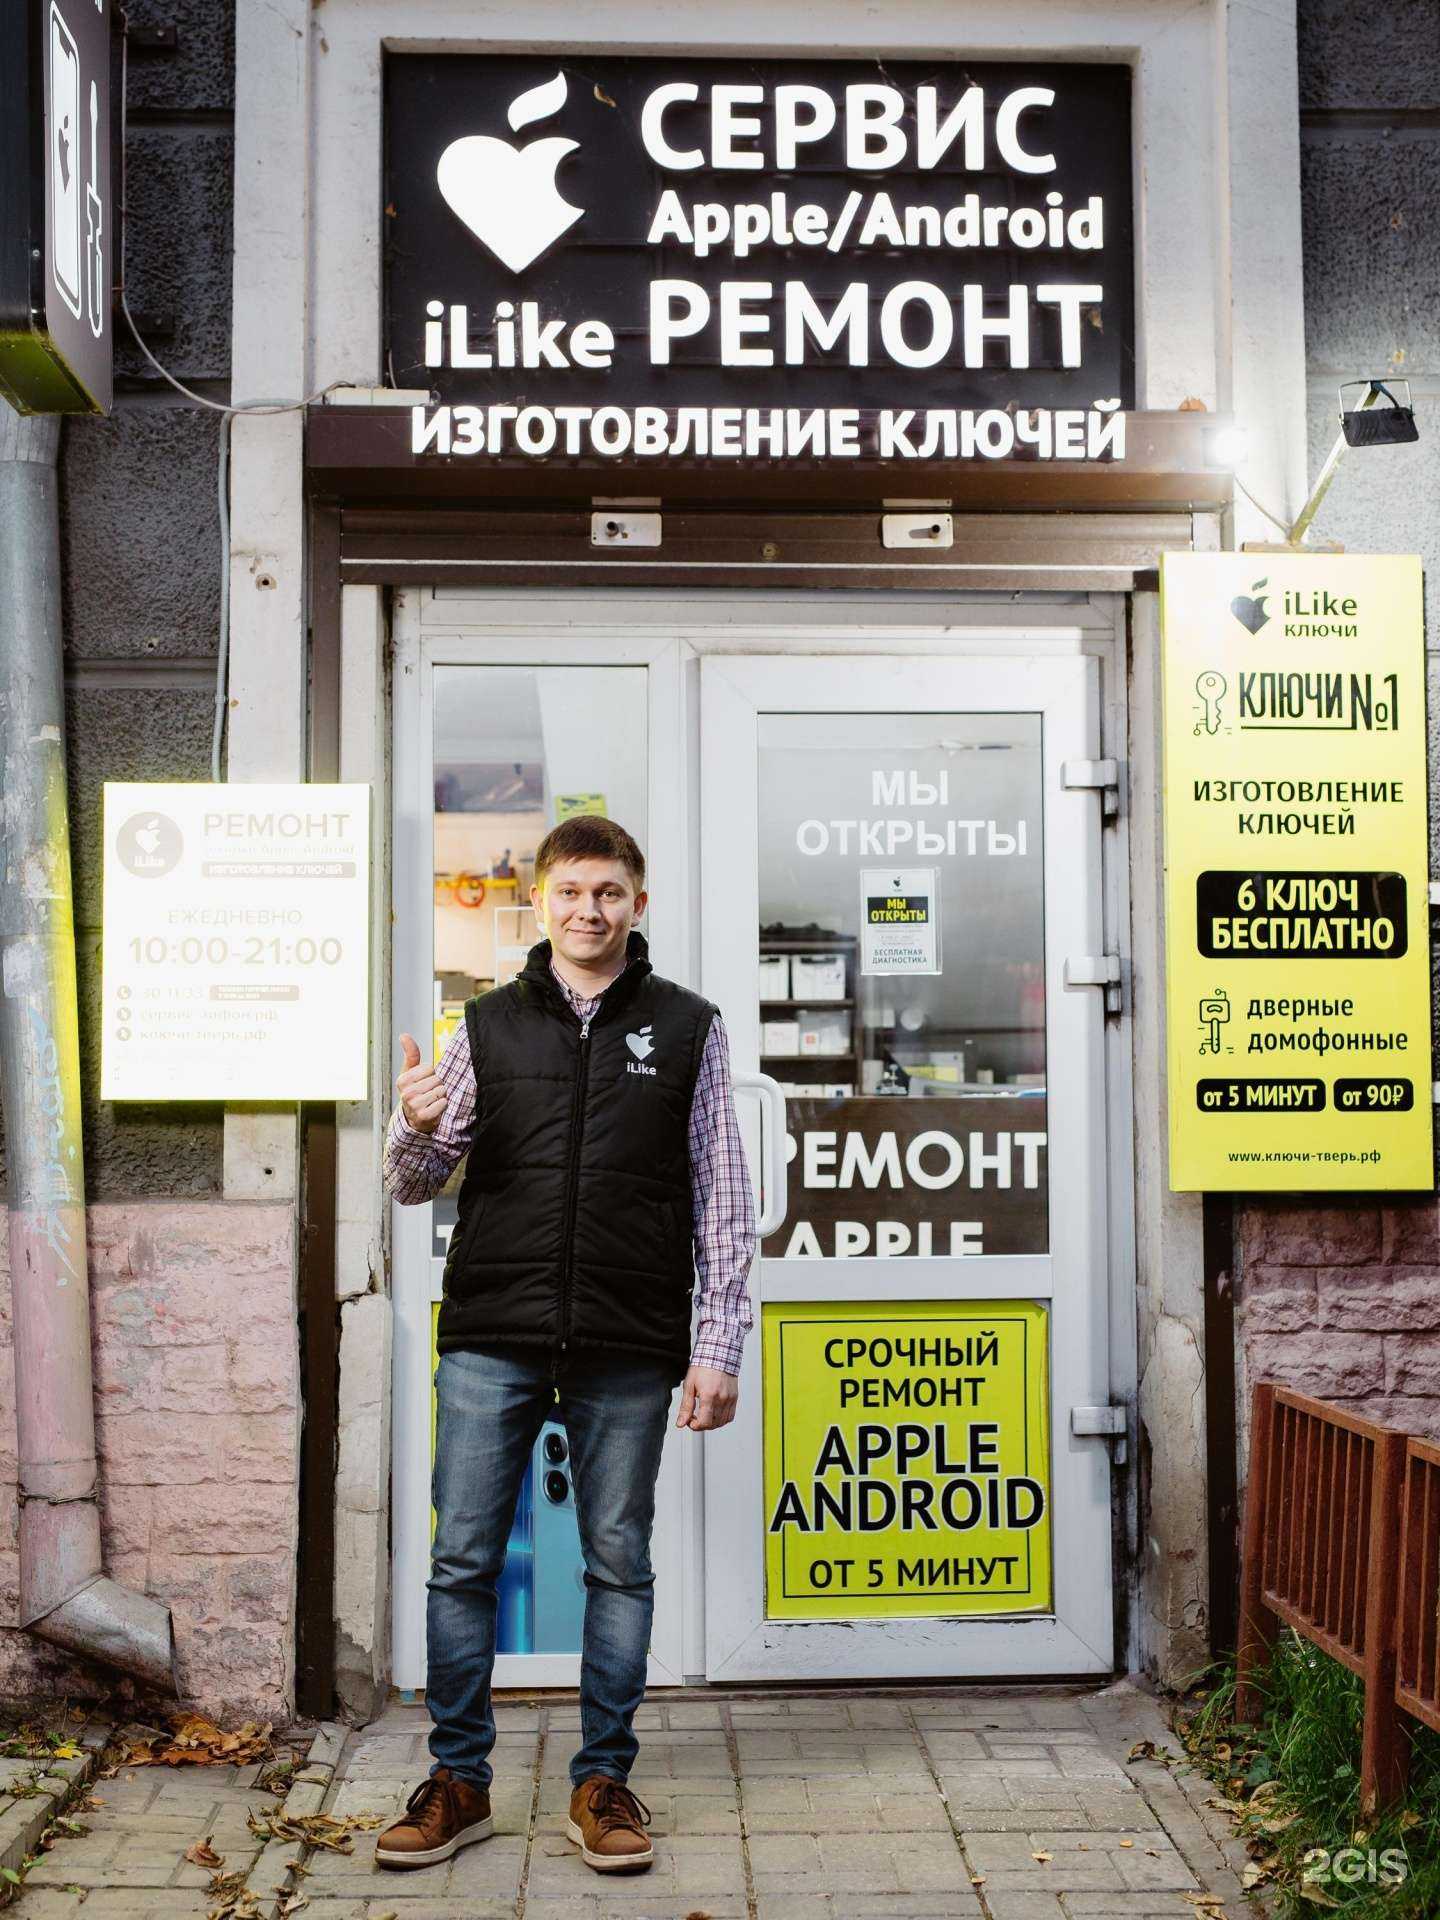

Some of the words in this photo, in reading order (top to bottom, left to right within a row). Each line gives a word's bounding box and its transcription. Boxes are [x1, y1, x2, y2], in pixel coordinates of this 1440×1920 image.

[641, 82, 1058, 174] СЕРВИС
[646, 190, 1104, 257] Apple/Android
[424, 300, 615, 369] iLike
[649, 279, 1104, 370] РЕМОНТ
[410, 405, 861, 457] ИЗГОТОВЛЕНИЕ
[879, 397, 1127, 460] КЛЮЧЕЙ
[1284, 590, 1358, 616] iLike
[1239, 672, 1343, 718] КЛЮЧИ
[872, 770, 948, 805] МЫ
[1193, 780, 1404, 803] ИЗГОТОВЛЕНИЕ
[203, 813, 350, 837] РЕМОНТ
[796, 819, 1027, 856] ОТКРЫТЫ
[1238, 809, 1355, 835] КЛЮЧЕЙ
[886, 898, 906, 910] МЫ
[1237, 879, 1256, 911] 6
[1266, 880, 1358, 911] КЛЮЧ
[167, 910, 303, 926] ЕЖЕДНЕВНО
[871, 909, 926, 922] ОТКРЫТЫ
[1212, 917, 1394, 949] БЕСПЛАТНО
[128, 937, 343, 966] 10:00-21:00
[1247, 998, 1354, 1022] дверные
[1247, 1027, 1408, 1056] домофонные
[626, 1061, 657, 1075] iLike
[1203, 1090, 1223, 1106] от
[1228, 1085, 1239, 1106] 5
[1246, 1085, 1317, 1106] МИНУТ
[1342, 1089, 1362, 1106] от
[1227, 1150, 1381, 1164] www.ключи-тверь.рф
[824, 1330, 999, 1368] СРОЧНЫЙ
[840, 1377, 985, 1408] РЕМОНТ
[814, 1424, 999, 1476] APPLE
[770, 1478, 1045, 1532] ANDROID
[809, 1559, 855, 1588] ОТ
[867, 1559, 884, 1587] 5
[897, 1557, 1018, 1587] МИНУТ
